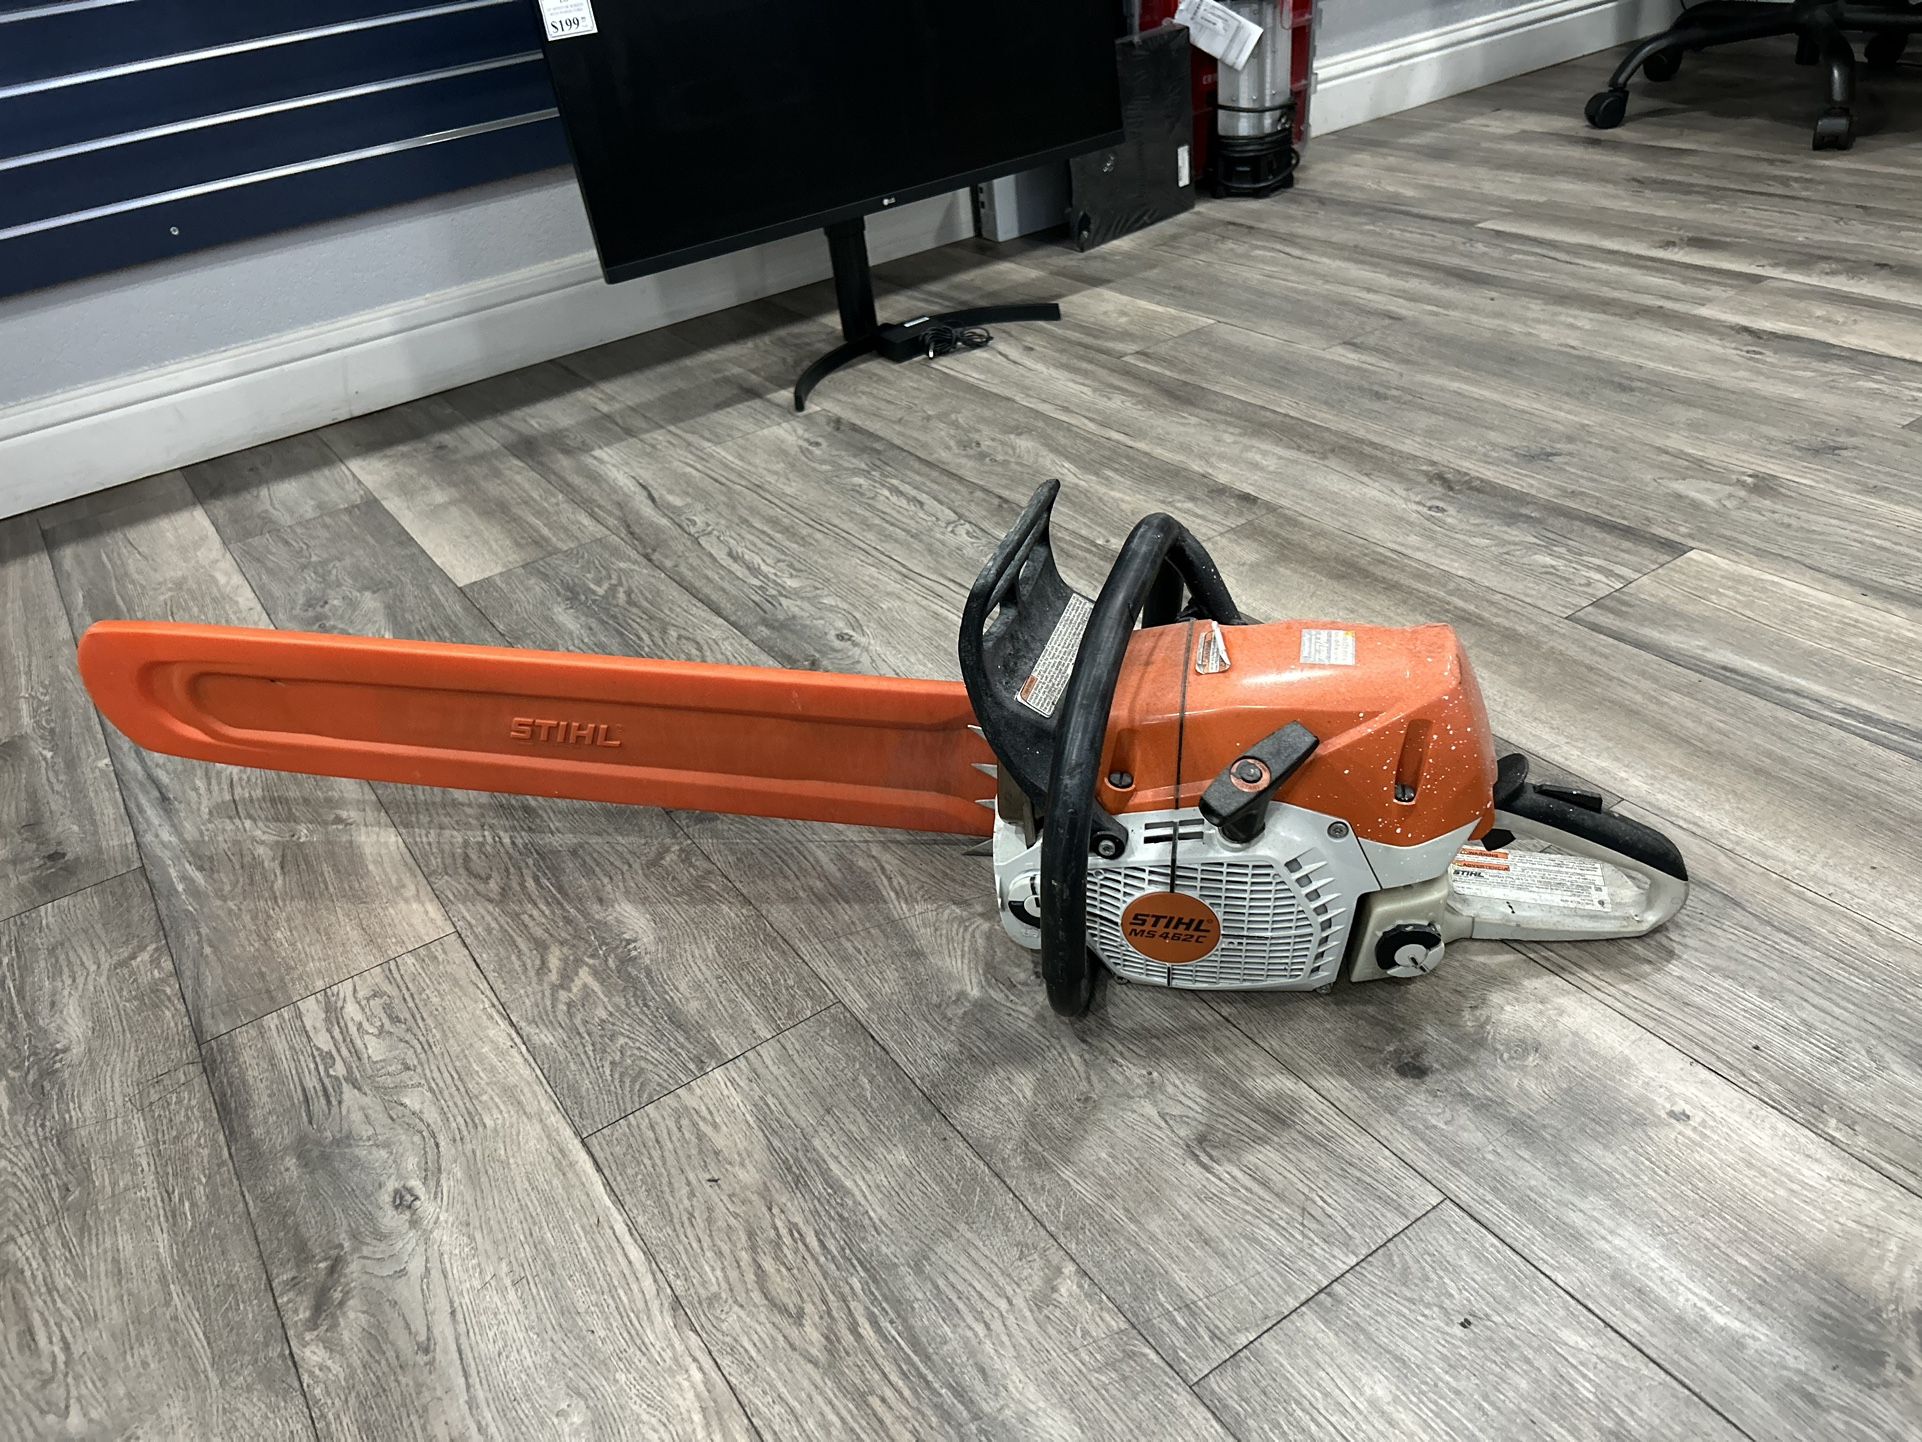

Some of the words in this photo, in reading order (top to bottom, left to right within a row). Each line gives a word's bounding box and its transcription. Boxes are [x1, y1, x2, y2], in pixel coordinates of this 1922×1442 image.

[510, 717, 621, 747] STIHL
[1453, 870, 1484, 878] STIHL
[1129, 913, 1211, 933] STIHL
[1129, 928, 1157, 939] MS
